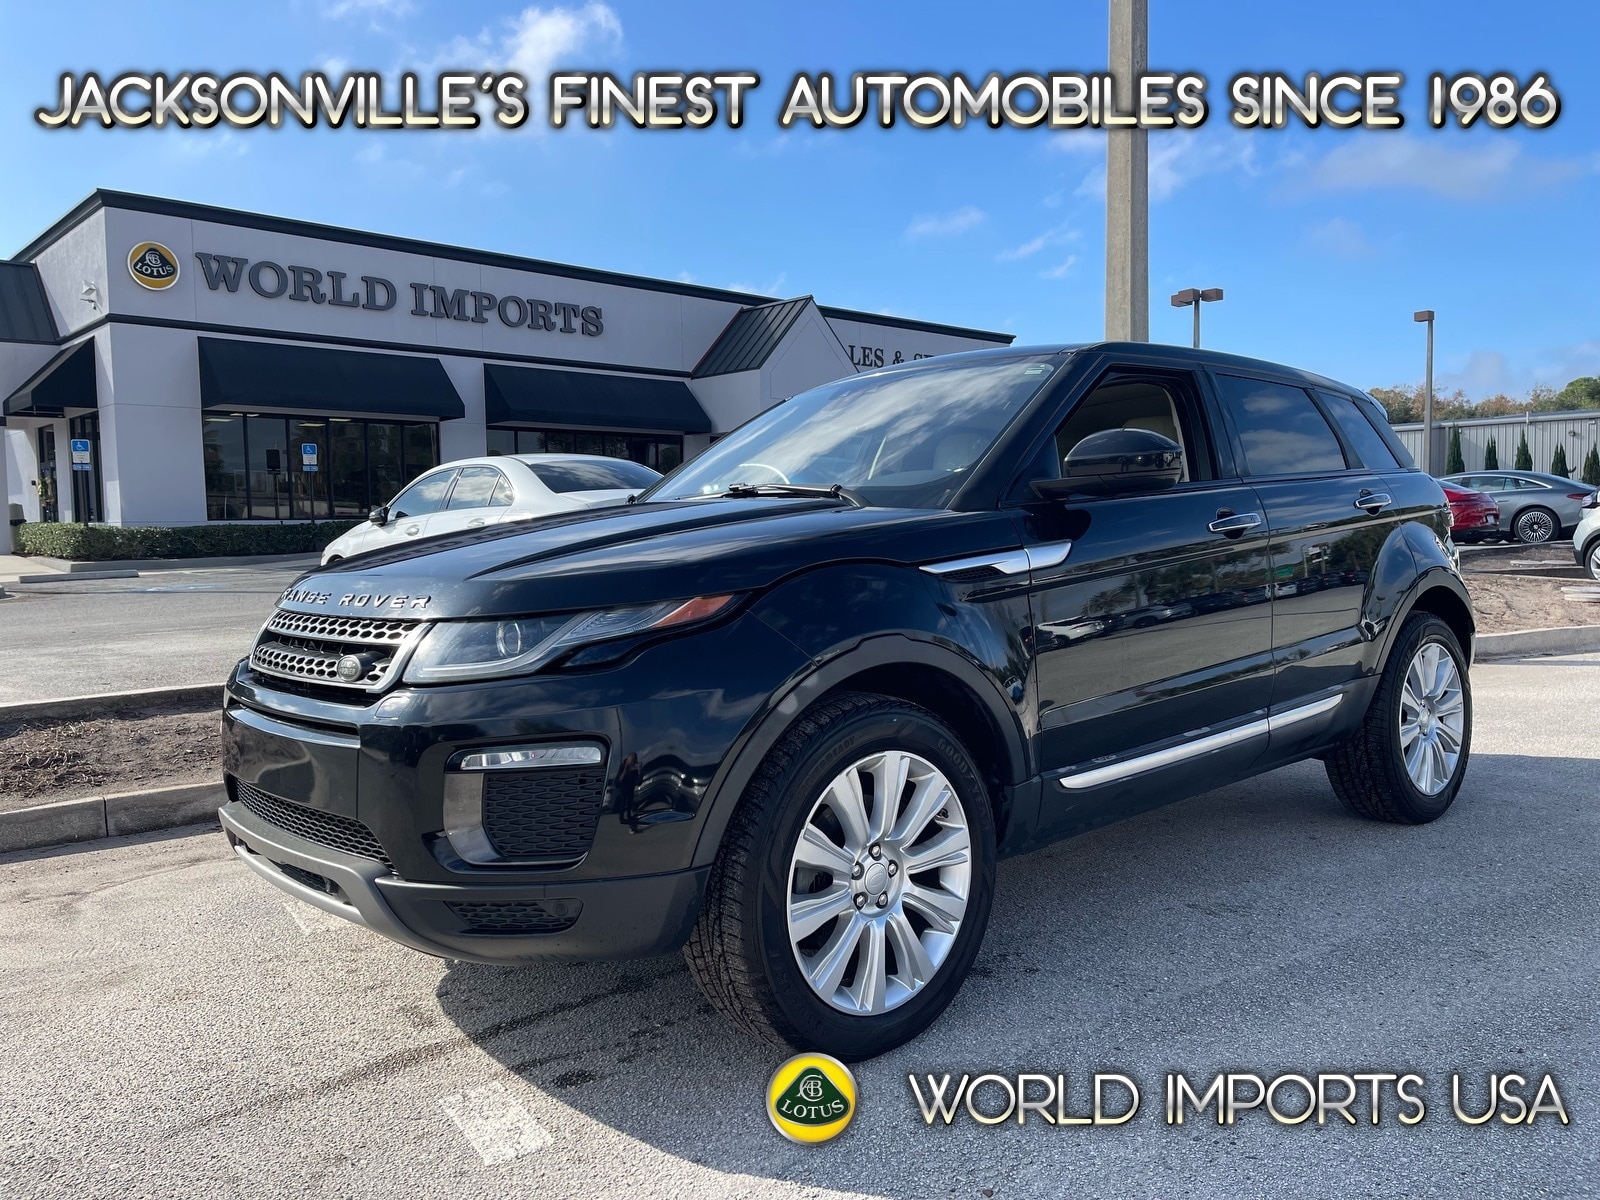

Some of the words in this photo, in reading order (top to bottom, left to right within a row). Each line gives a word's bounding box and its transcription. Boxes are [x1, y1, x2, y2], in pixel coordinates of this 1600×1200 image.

[135, 262, 174, 276] LOTUS
[195, 251, 398, 311] WORLD
[410, 282, 604, 337] IMPORTS
[281, 587, 332, 605] RANGE
[339, 593, 432, 609] ROVER
